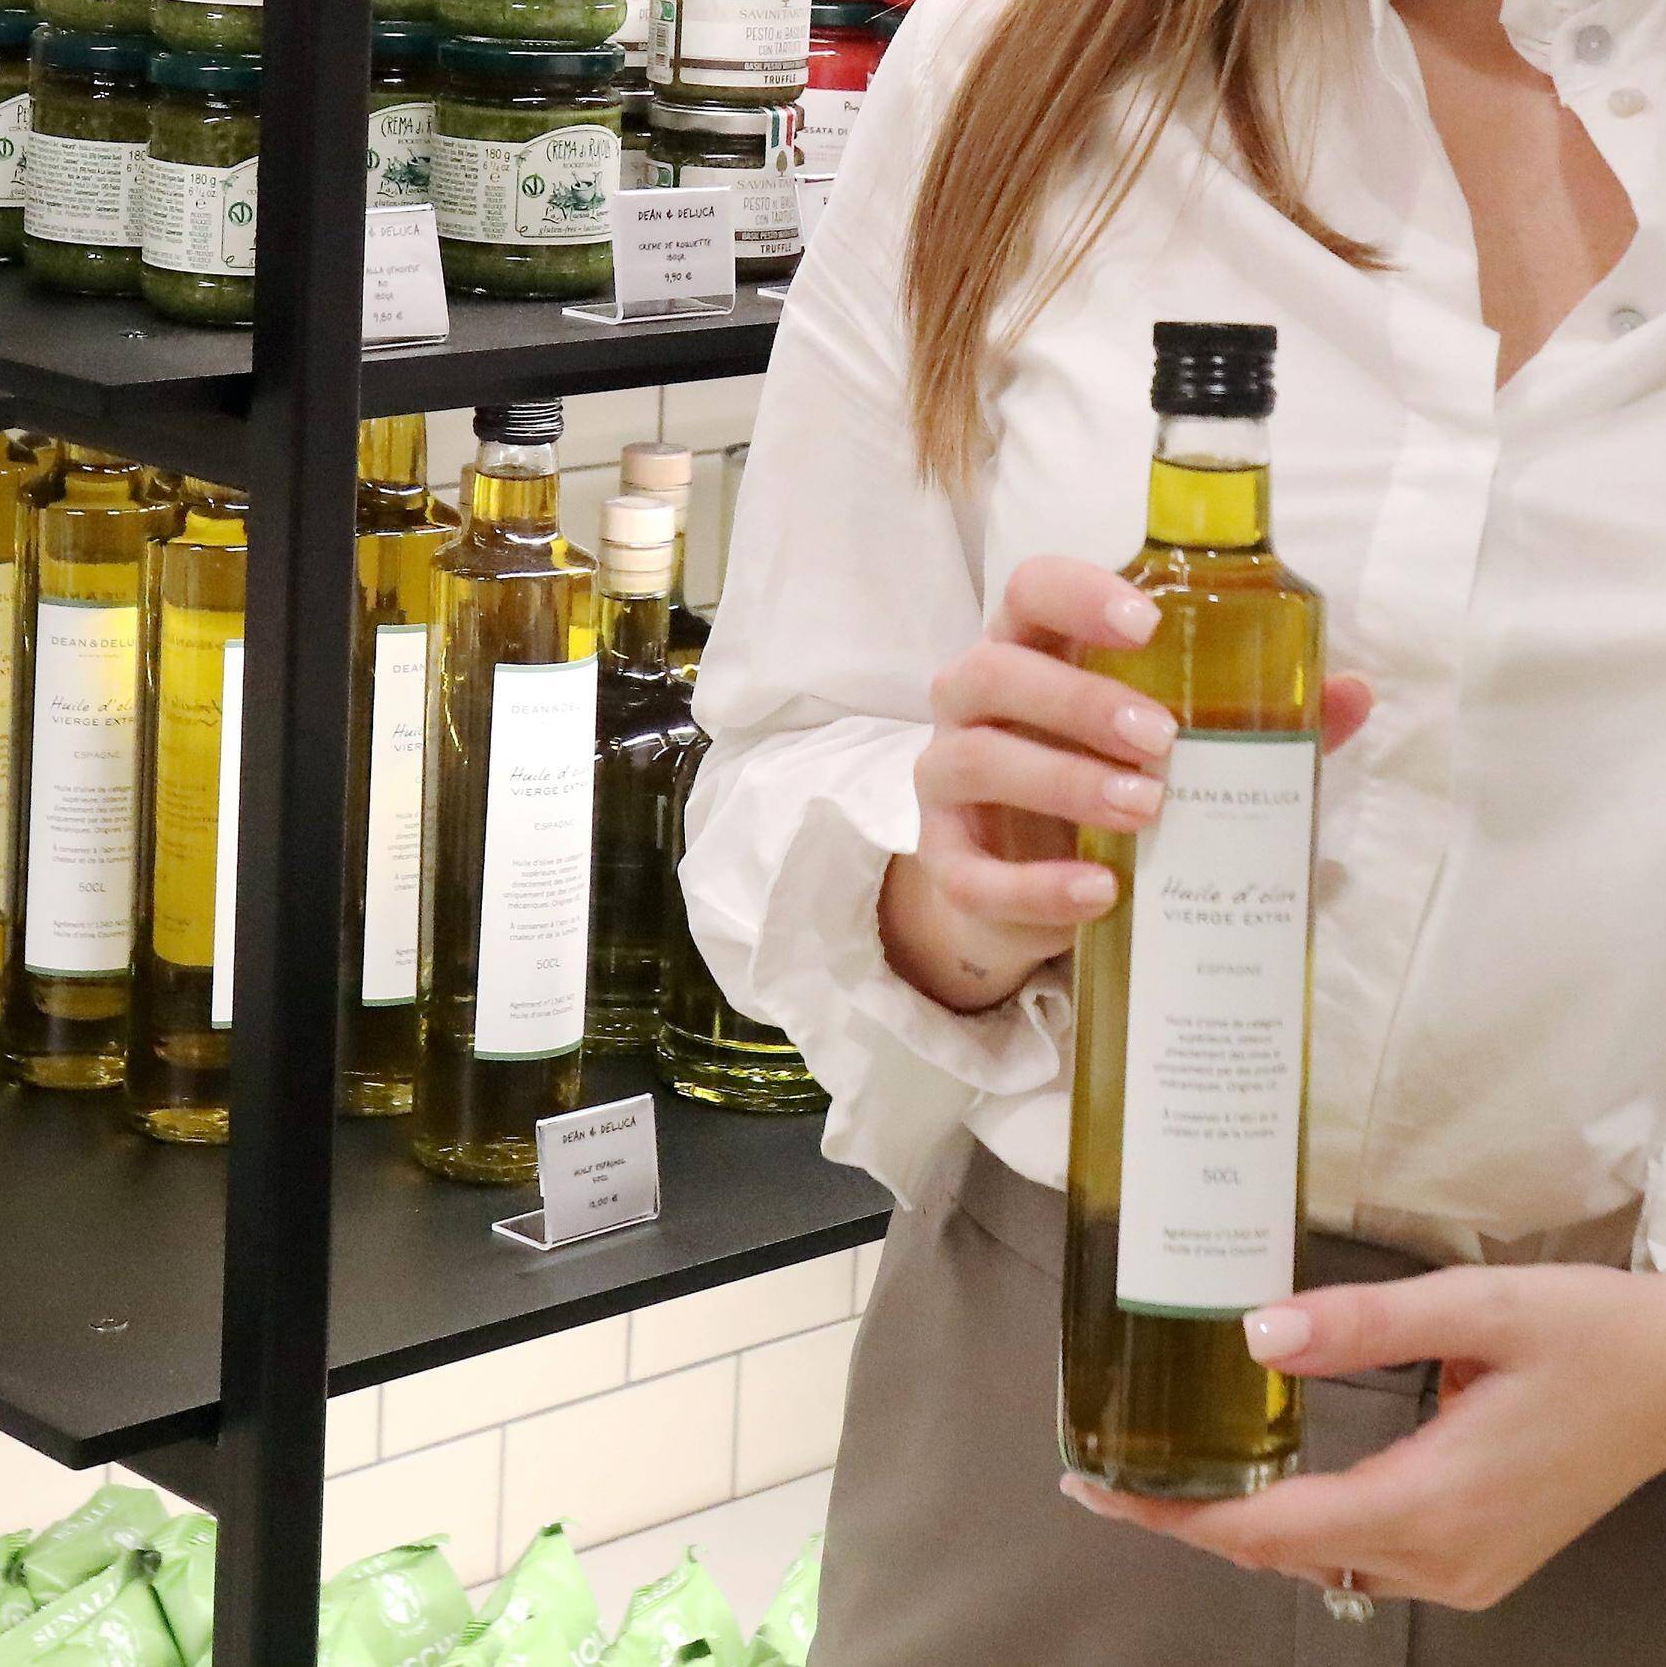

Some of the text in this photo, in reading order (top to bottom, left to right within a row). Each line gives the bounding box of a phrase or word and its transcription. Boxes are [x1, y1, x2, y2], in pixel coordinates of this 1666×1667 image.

[764, 74, 797, 85] TRUFFLE
[485, 148, 502, 159] 180
[190, 174, 208, 185] 180
[638, 209, 662, 221] DEAN
[678, 206, 715, 219] DELUCA
[760, 243, 792, 254] TRUFFLE
[51, 695, 91, 713] Huile
[52, 716, 99, 727] VIERGE
[511, 785, 559, 798] VIERGE
[1163, 910, 1234, 925] VIERGE
[563, 1130, 585, 1144] DEAN
[601, 1116, 637, 1134] DELUCA
